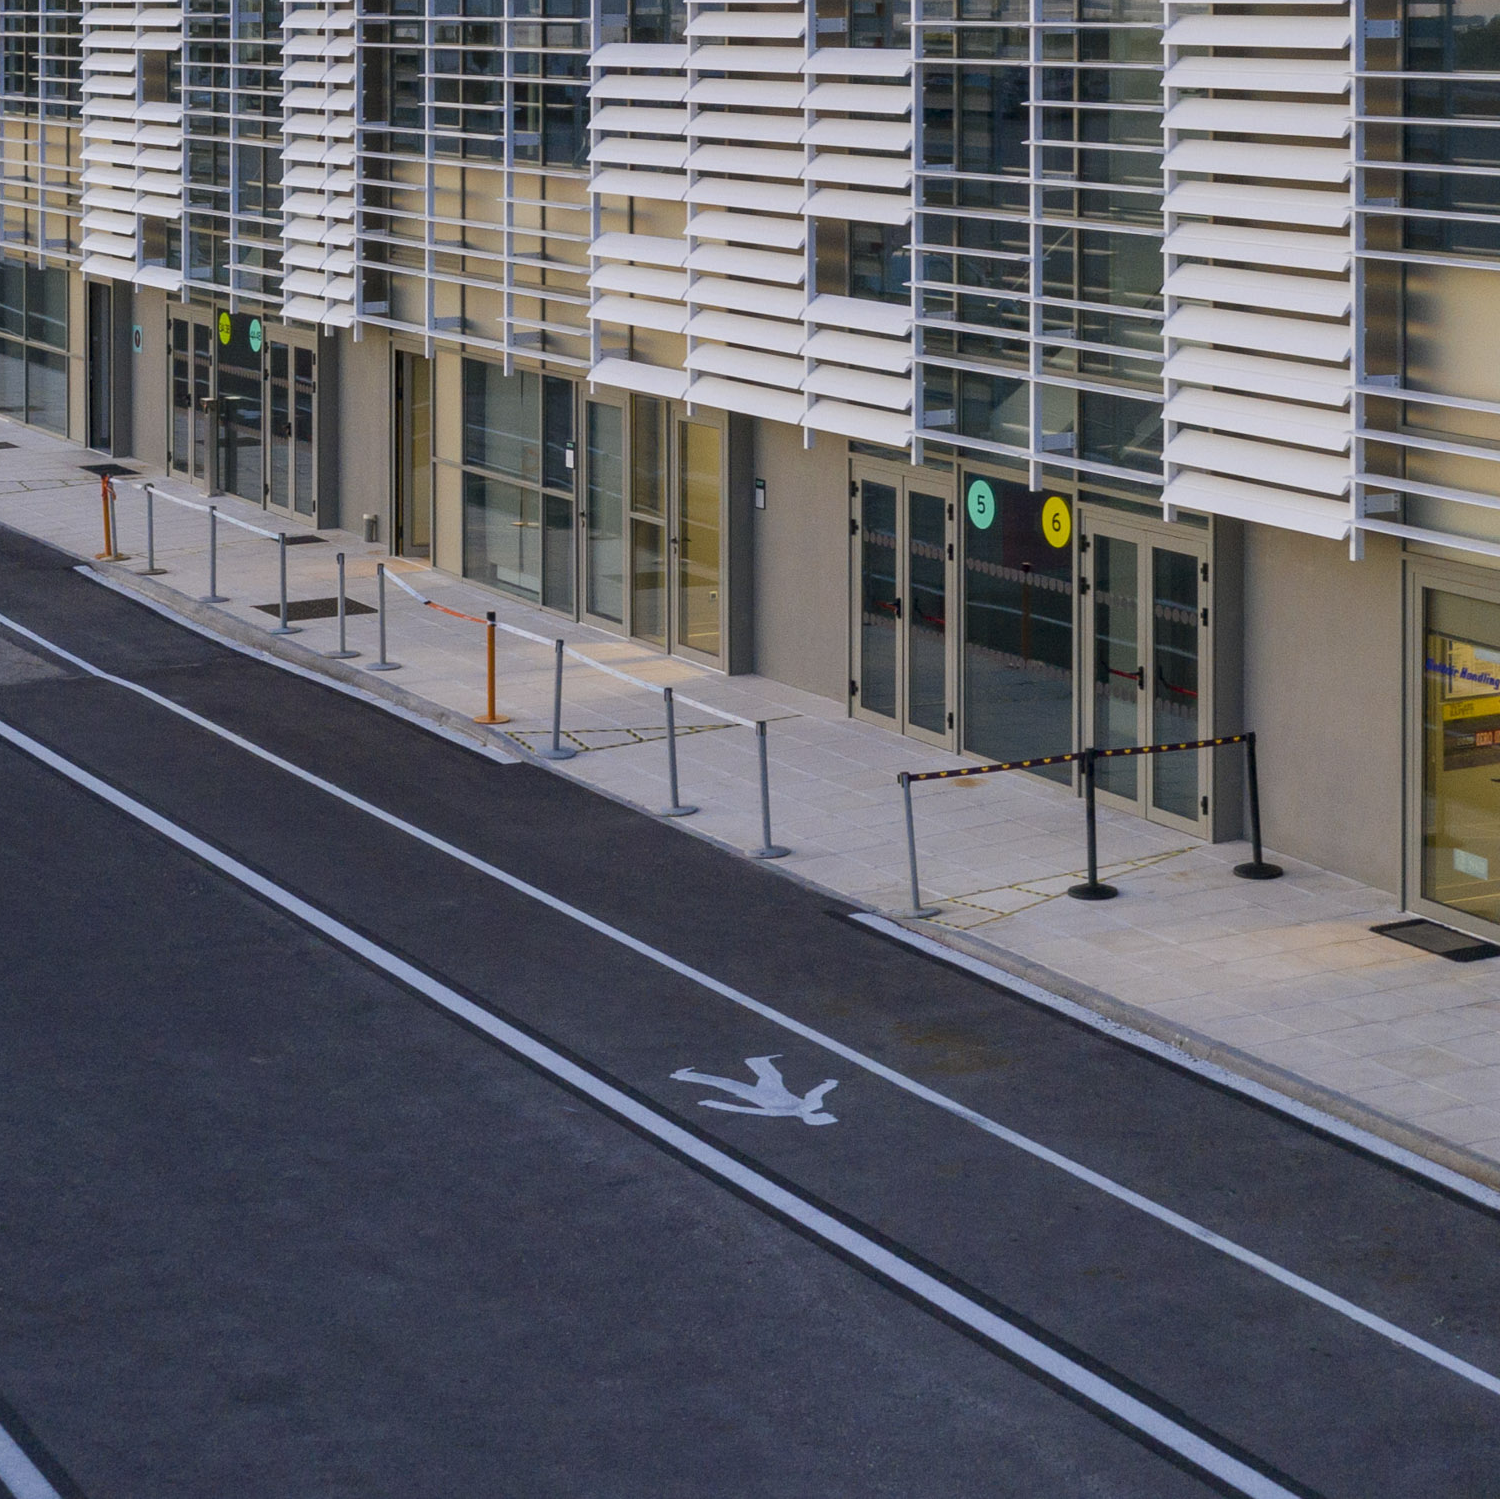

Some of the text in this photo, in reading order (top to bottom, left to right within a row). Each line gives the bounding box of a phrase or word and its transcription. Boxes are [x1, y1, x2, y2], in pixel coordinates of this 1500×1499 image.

[977, 495, 985, 514] 5
[1052, 513, 1061, 532] 6
[1460, 667, 1500, 690] Handling
